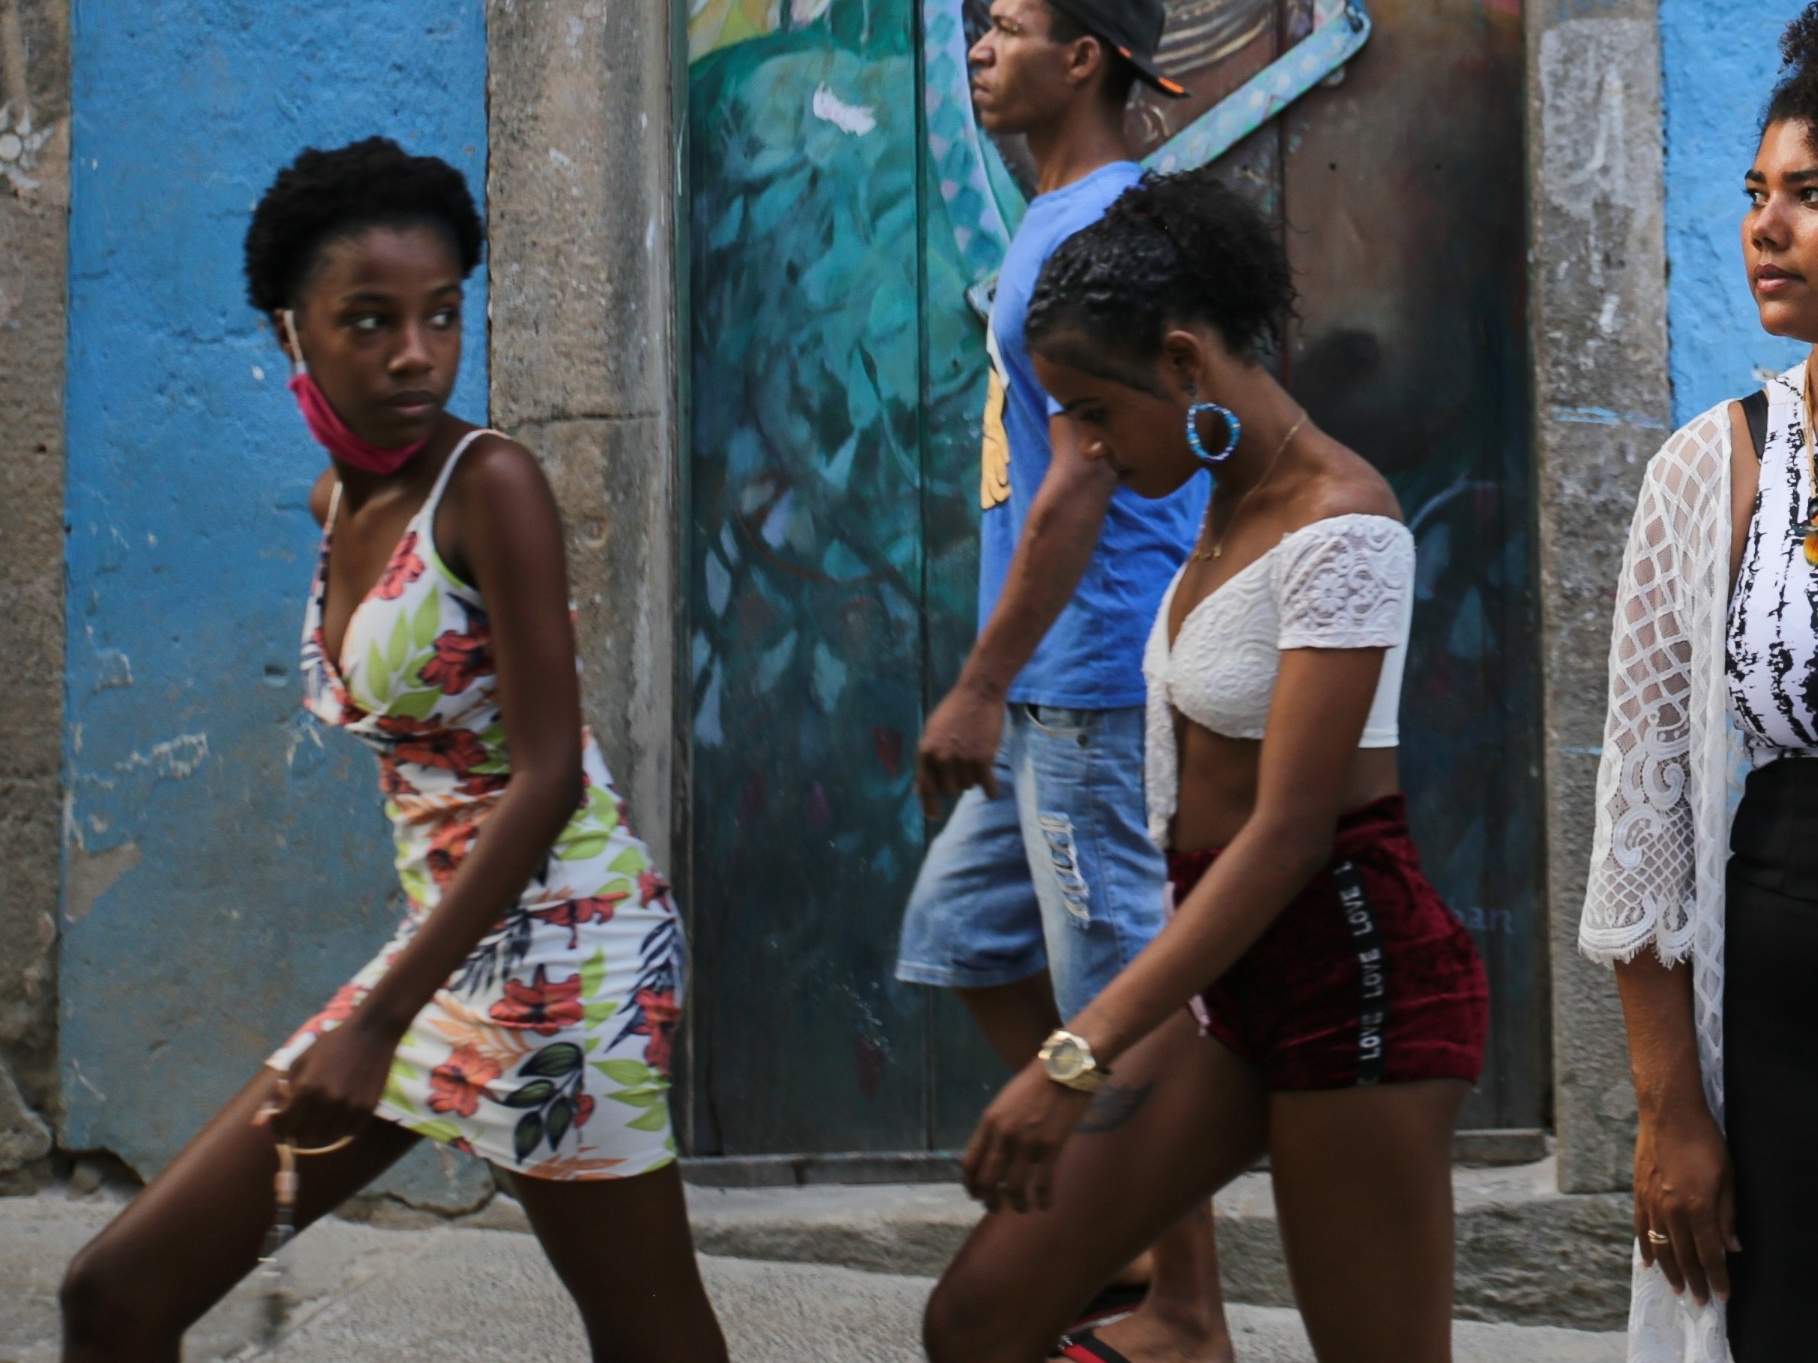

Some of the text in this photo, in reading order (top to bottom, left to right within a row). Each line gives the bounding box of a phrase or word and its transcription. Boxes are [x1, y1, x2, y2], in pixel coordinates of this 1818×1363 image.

[1340, 884, 1373, 937] LOVE
[1358, 948, 1384, 999] LOVE
[1358, 1011, 1384, 1061] LOVE
